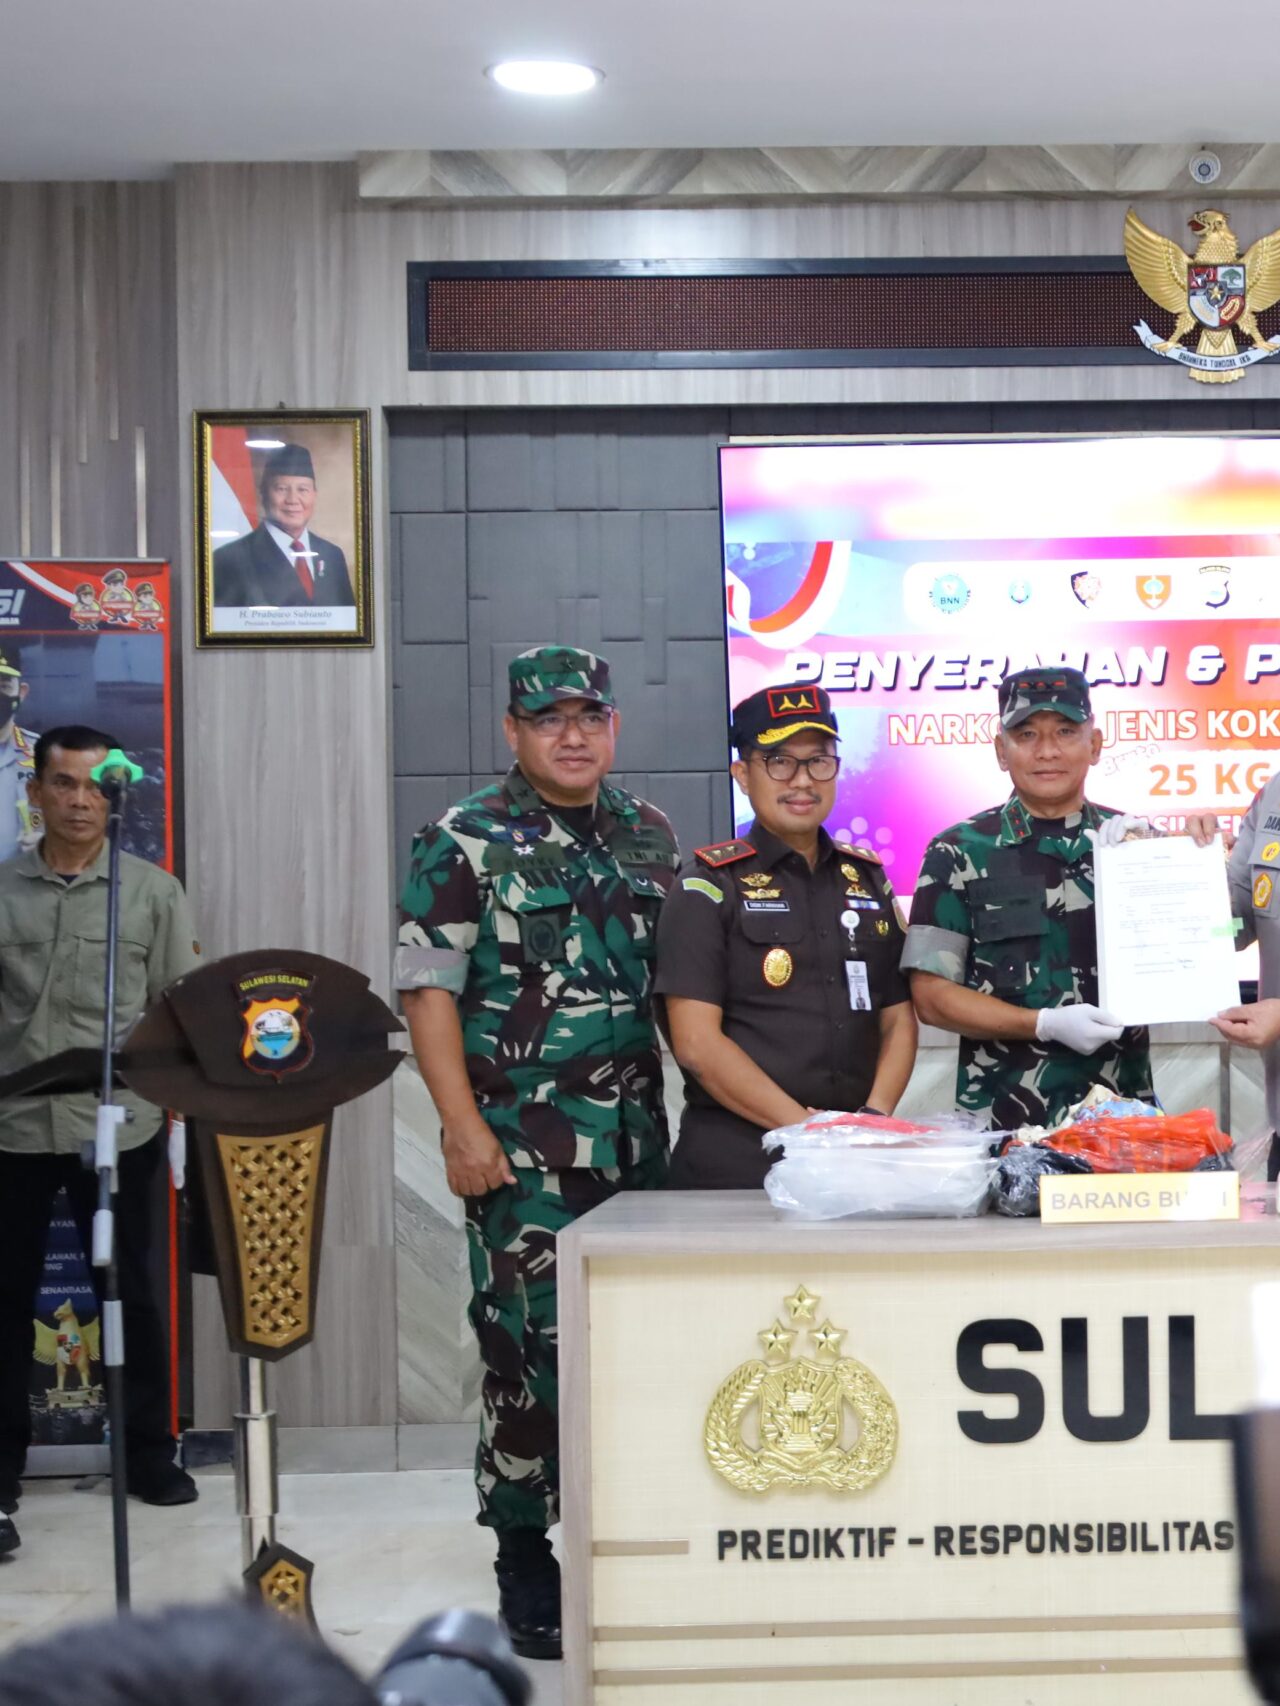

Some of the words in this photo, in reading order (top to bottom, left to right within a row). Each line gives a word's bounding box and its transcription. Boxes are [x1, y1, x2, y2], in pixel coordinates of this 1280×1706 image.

[940, 597, 960, 605] BNN
[1185, 644, 1226, 685] &
[1101, 709, 1199, 748] JENIS
[1149, 763, 1198, 797] 25
[240, 974, 276, 991] SULAWESI
[277, 974, 309, 988] SELATAN
[1051, 1191, 1150, 1210] BARANG
[1158, 1190, 1227, 1208] BUI
[717, 1526, 897, 1561] PREDIKTIF
[933, 1519, 1236, 1556] RESPONSIBILITAS
